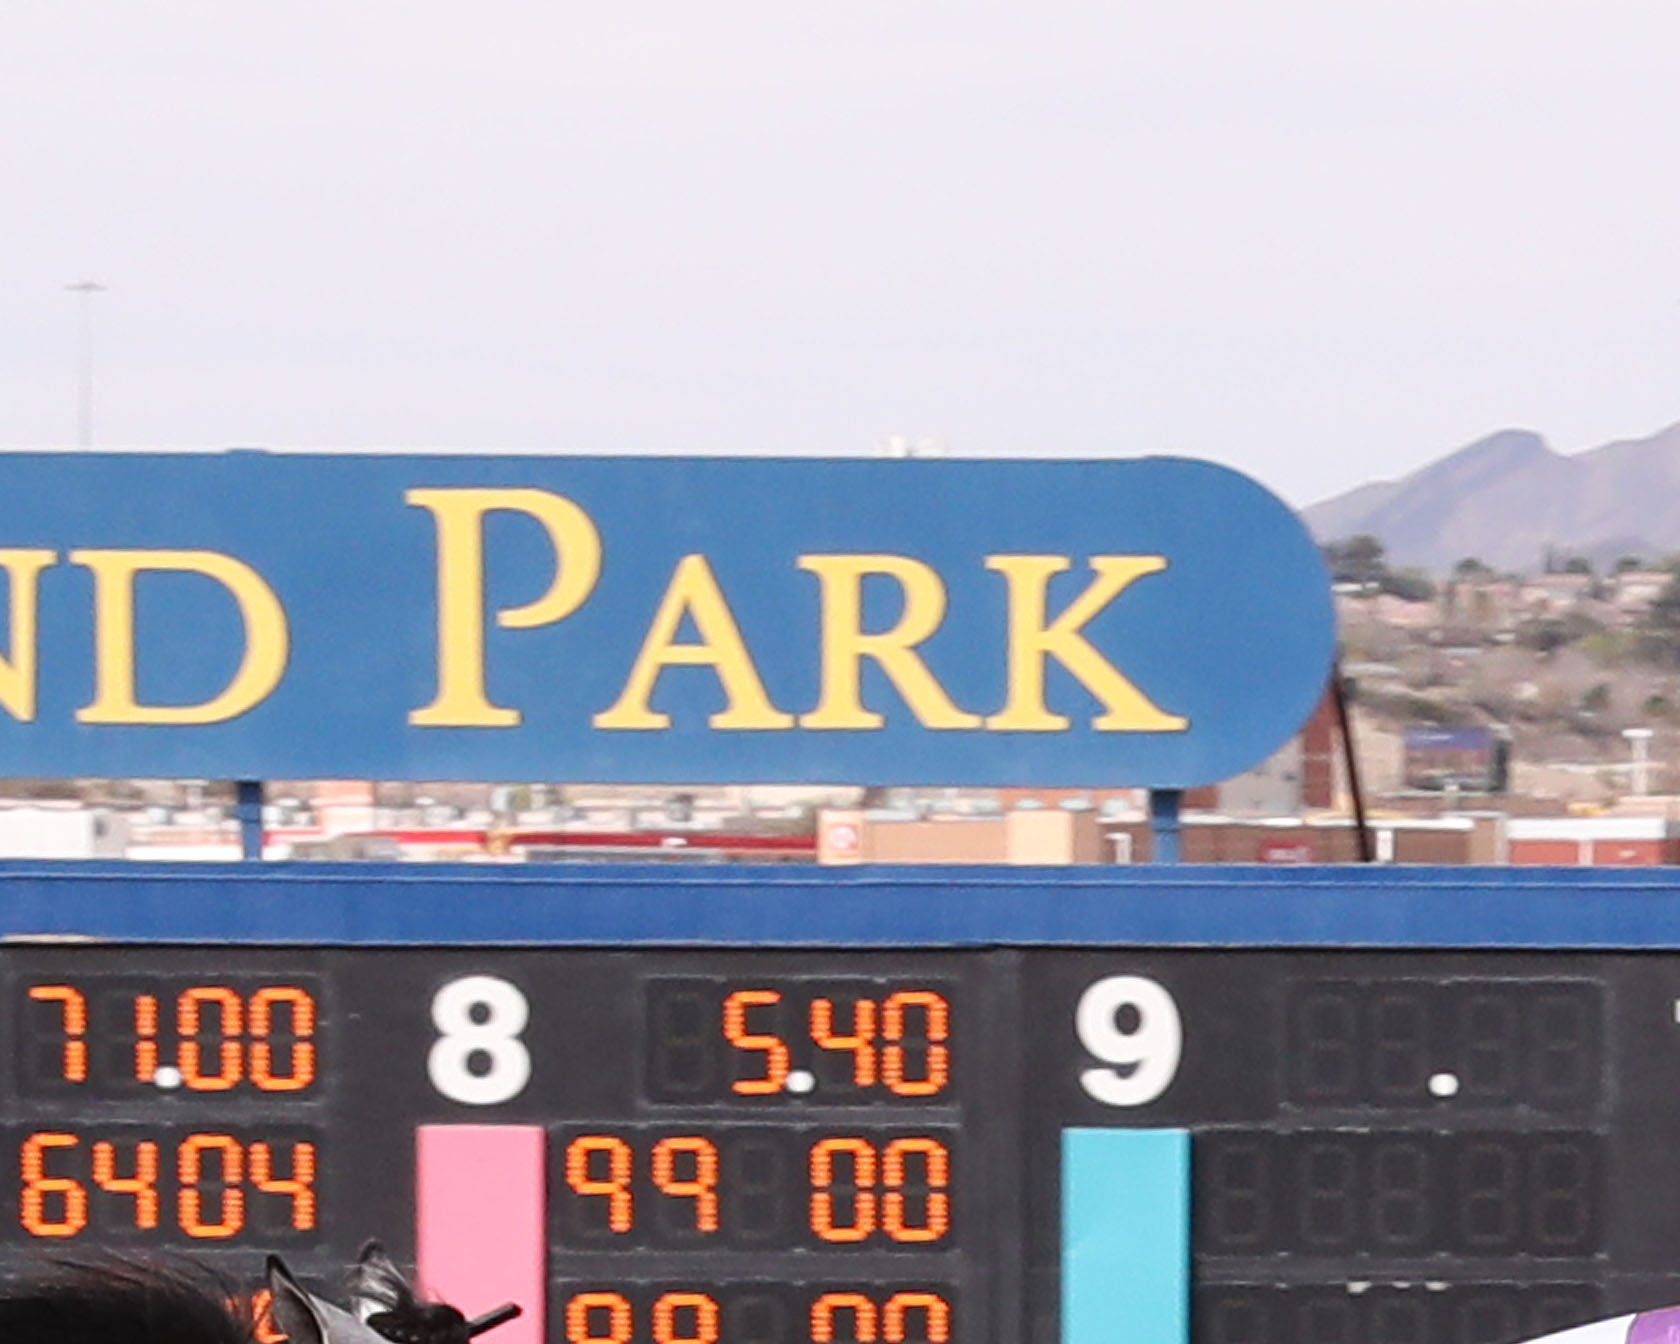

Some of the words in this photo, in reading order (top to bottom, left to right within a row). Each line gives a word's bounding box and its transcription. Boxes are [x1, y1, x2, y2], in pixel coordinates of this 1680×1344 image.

[405, 487, 1188, 733] PARK
[27, 985, 316, 1091] 71.00
[428, 975, 531, 1105] 8
[722, 990, 950, 1096] 5.40
[1076, 976, 1182, 1106] 9
